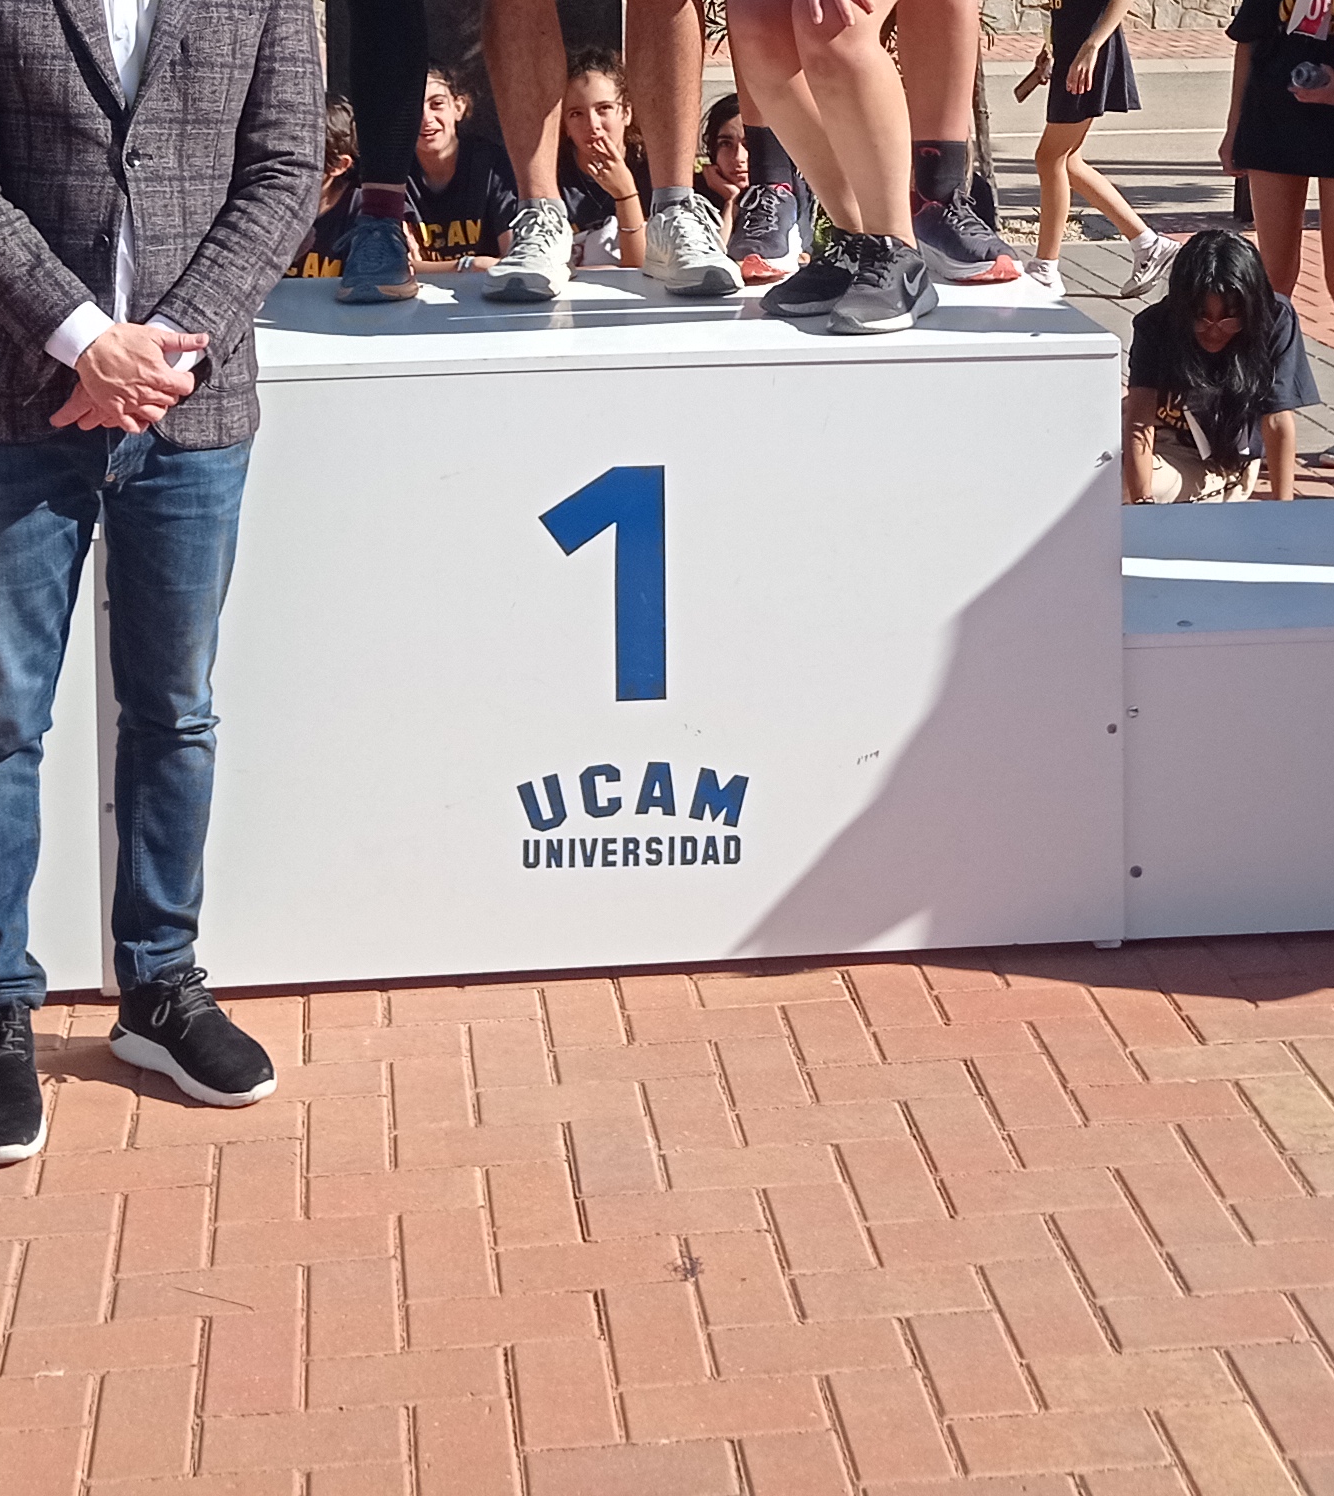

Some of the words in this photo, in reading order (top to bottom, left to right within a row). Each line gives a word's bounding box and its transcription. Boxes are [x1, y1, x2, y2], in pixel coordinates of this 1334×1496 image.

[539, 465, 666, 701] 1
[517, 762, 749, 832] UCAM
[523, 835, 741, 868] UNIVERSIDAD
